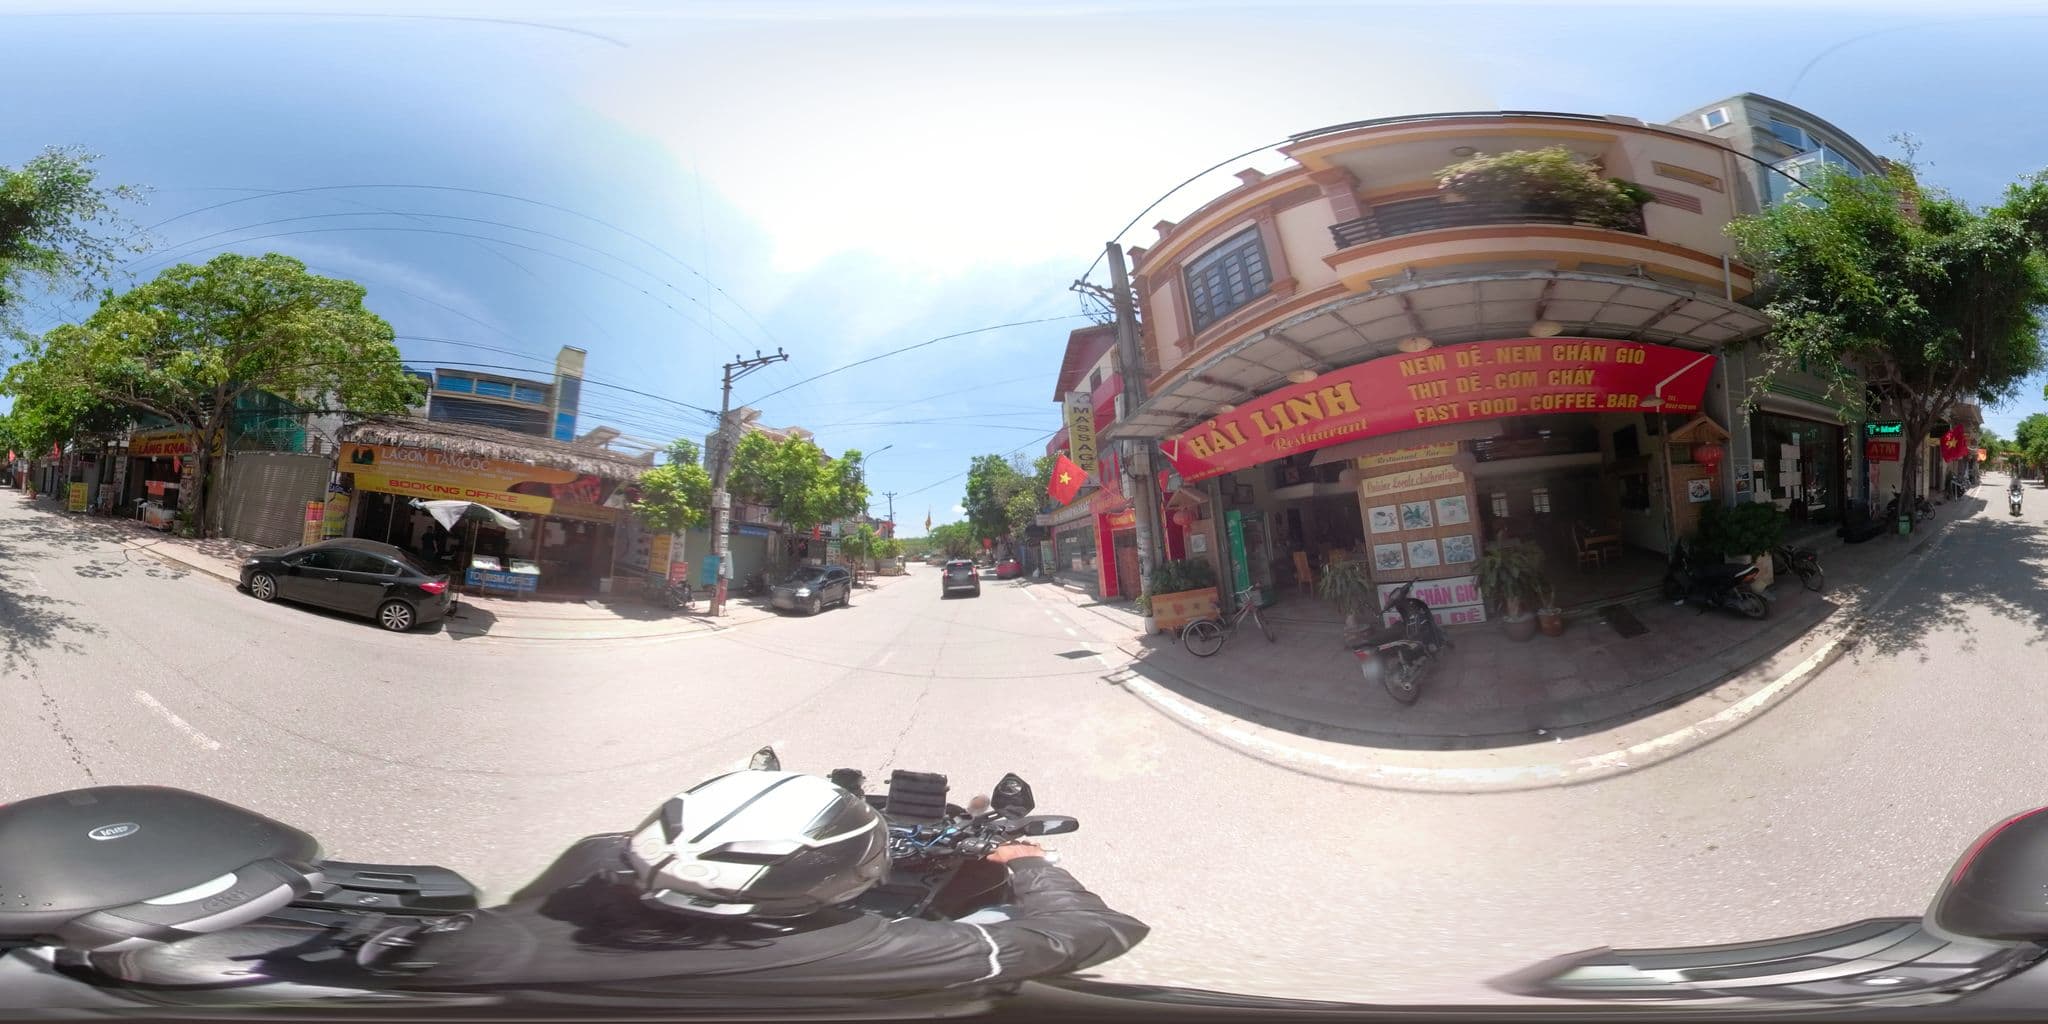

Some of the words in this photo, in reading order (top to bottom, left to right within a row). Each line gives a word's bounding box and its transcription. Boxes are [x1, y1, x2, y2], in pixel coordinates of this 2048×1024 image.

[1400, 354, 1446, 377] NEM
[1250, 383, 1361, 437] LINH
[1414, 402, 1460, 424] FAST
[1073, 406, 1097, 471] MASSAGE
[1271, 417, 1370, 452] Restaurant
[381, 446, 429, 464] LAGOM
[1871, 442, 1897, 455] ATM
[389, 479, 459, 495] BOOKING
[465, 489, 519, 503] OFFICE
